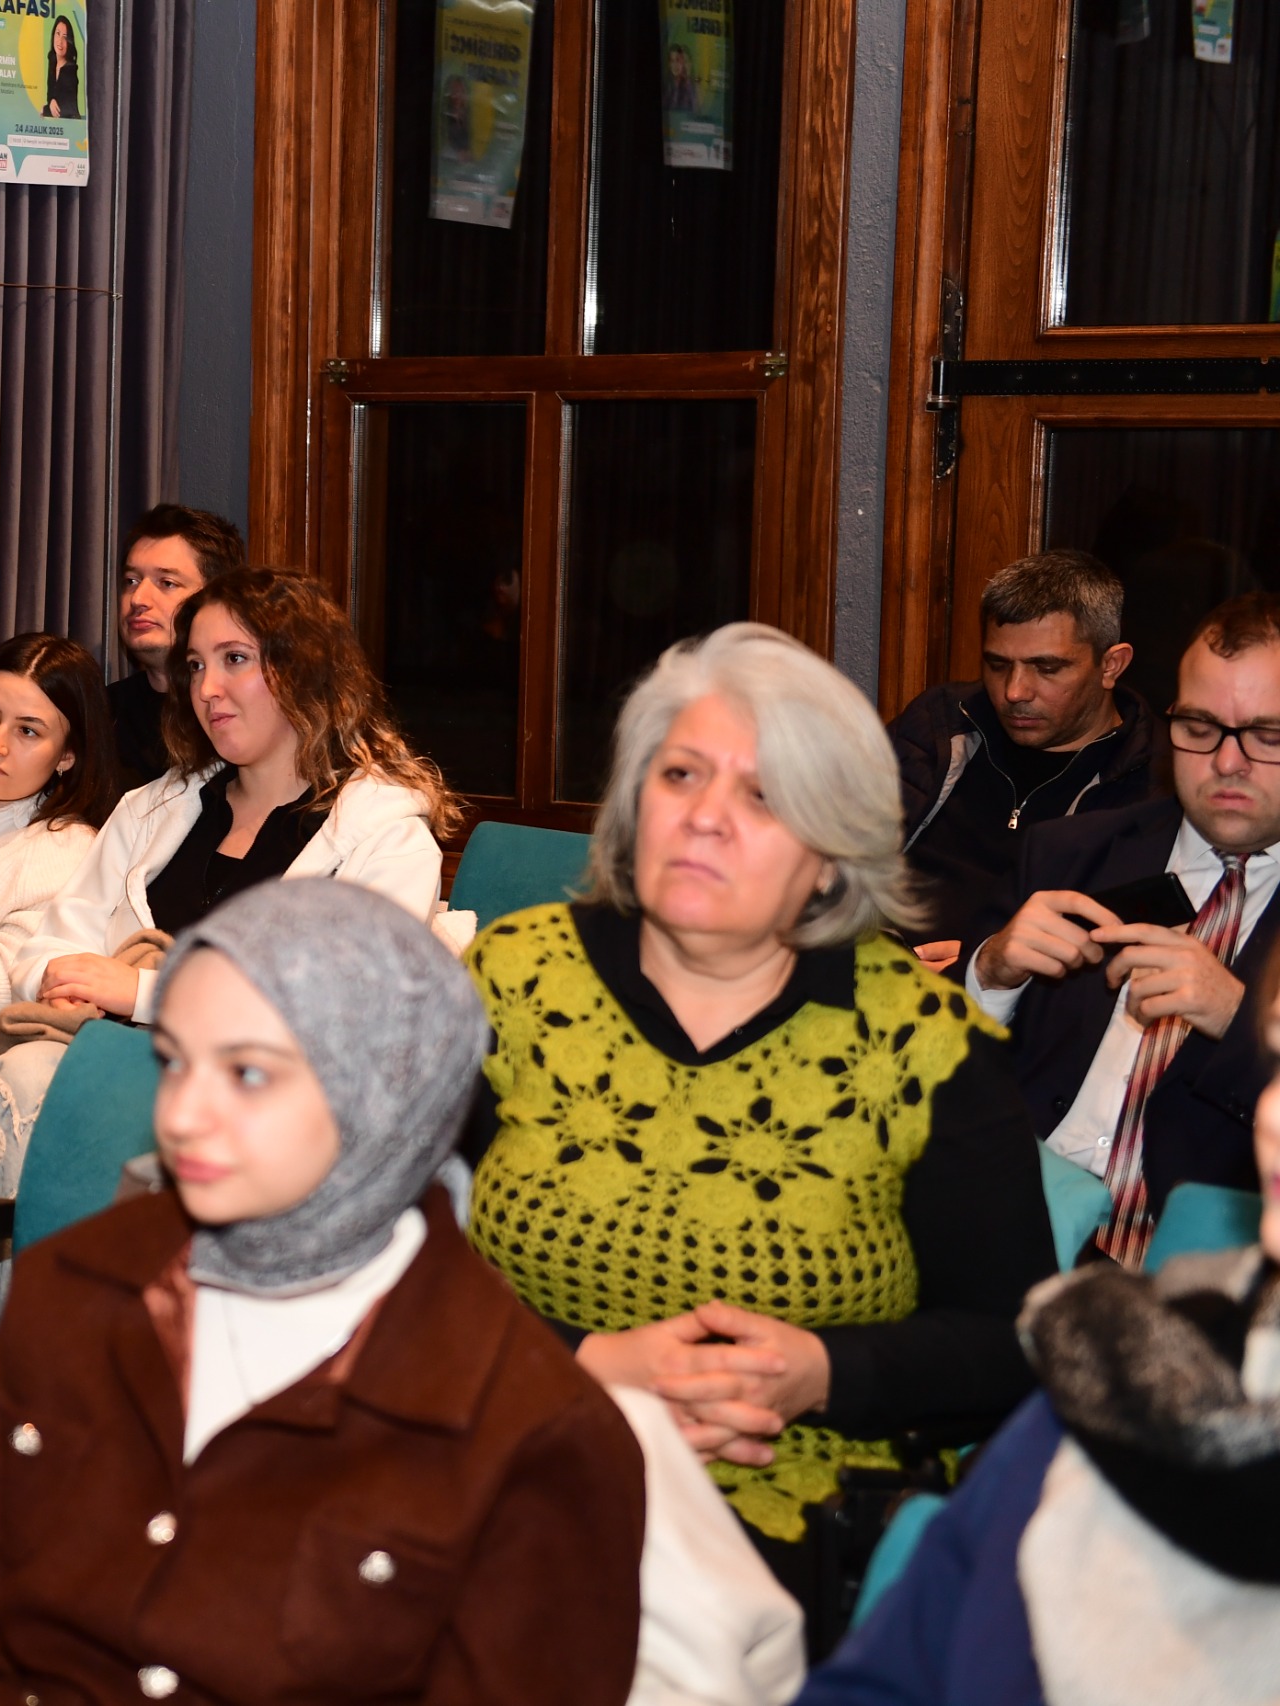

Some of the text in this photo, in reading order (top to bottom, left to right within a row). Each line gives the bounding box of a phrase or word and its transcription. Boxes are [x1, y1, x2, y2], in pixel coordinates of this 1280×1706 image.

[15, 123, 64, 136] 24 ARALIK 2025
